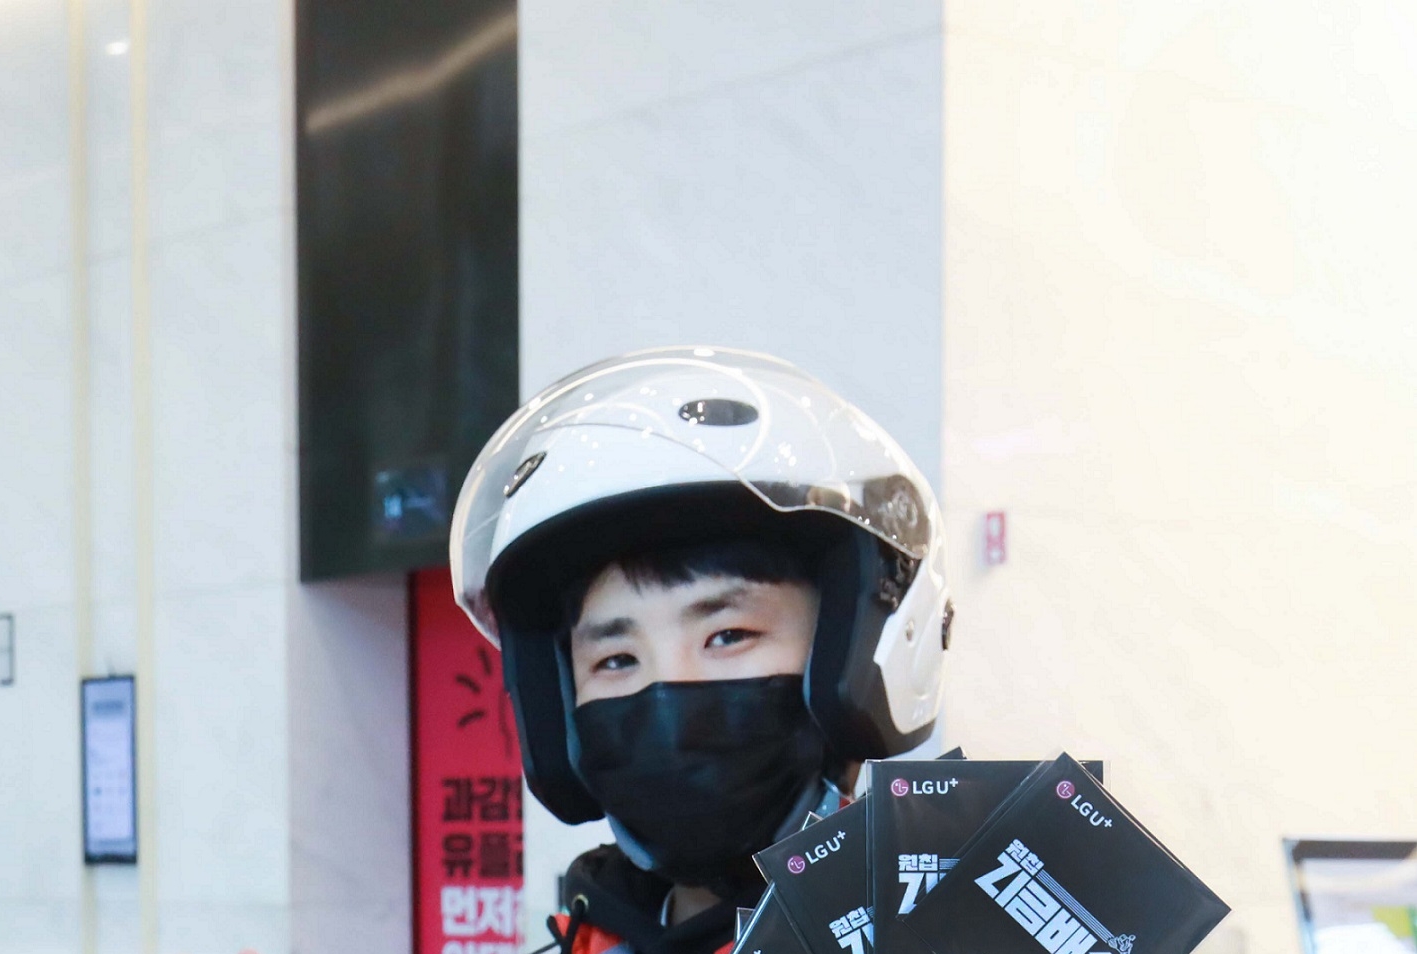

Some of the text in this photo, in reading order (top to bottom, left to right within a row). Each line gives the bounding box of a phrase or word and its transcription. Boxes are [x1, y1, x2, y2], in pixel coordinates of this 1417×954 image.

[441, 777, 524, 823] 과감
[898, 853, 938, 872] 원칩
[1004, 838, 1045, 877] 원칩
[828, 906, 871, 939] 원칩
